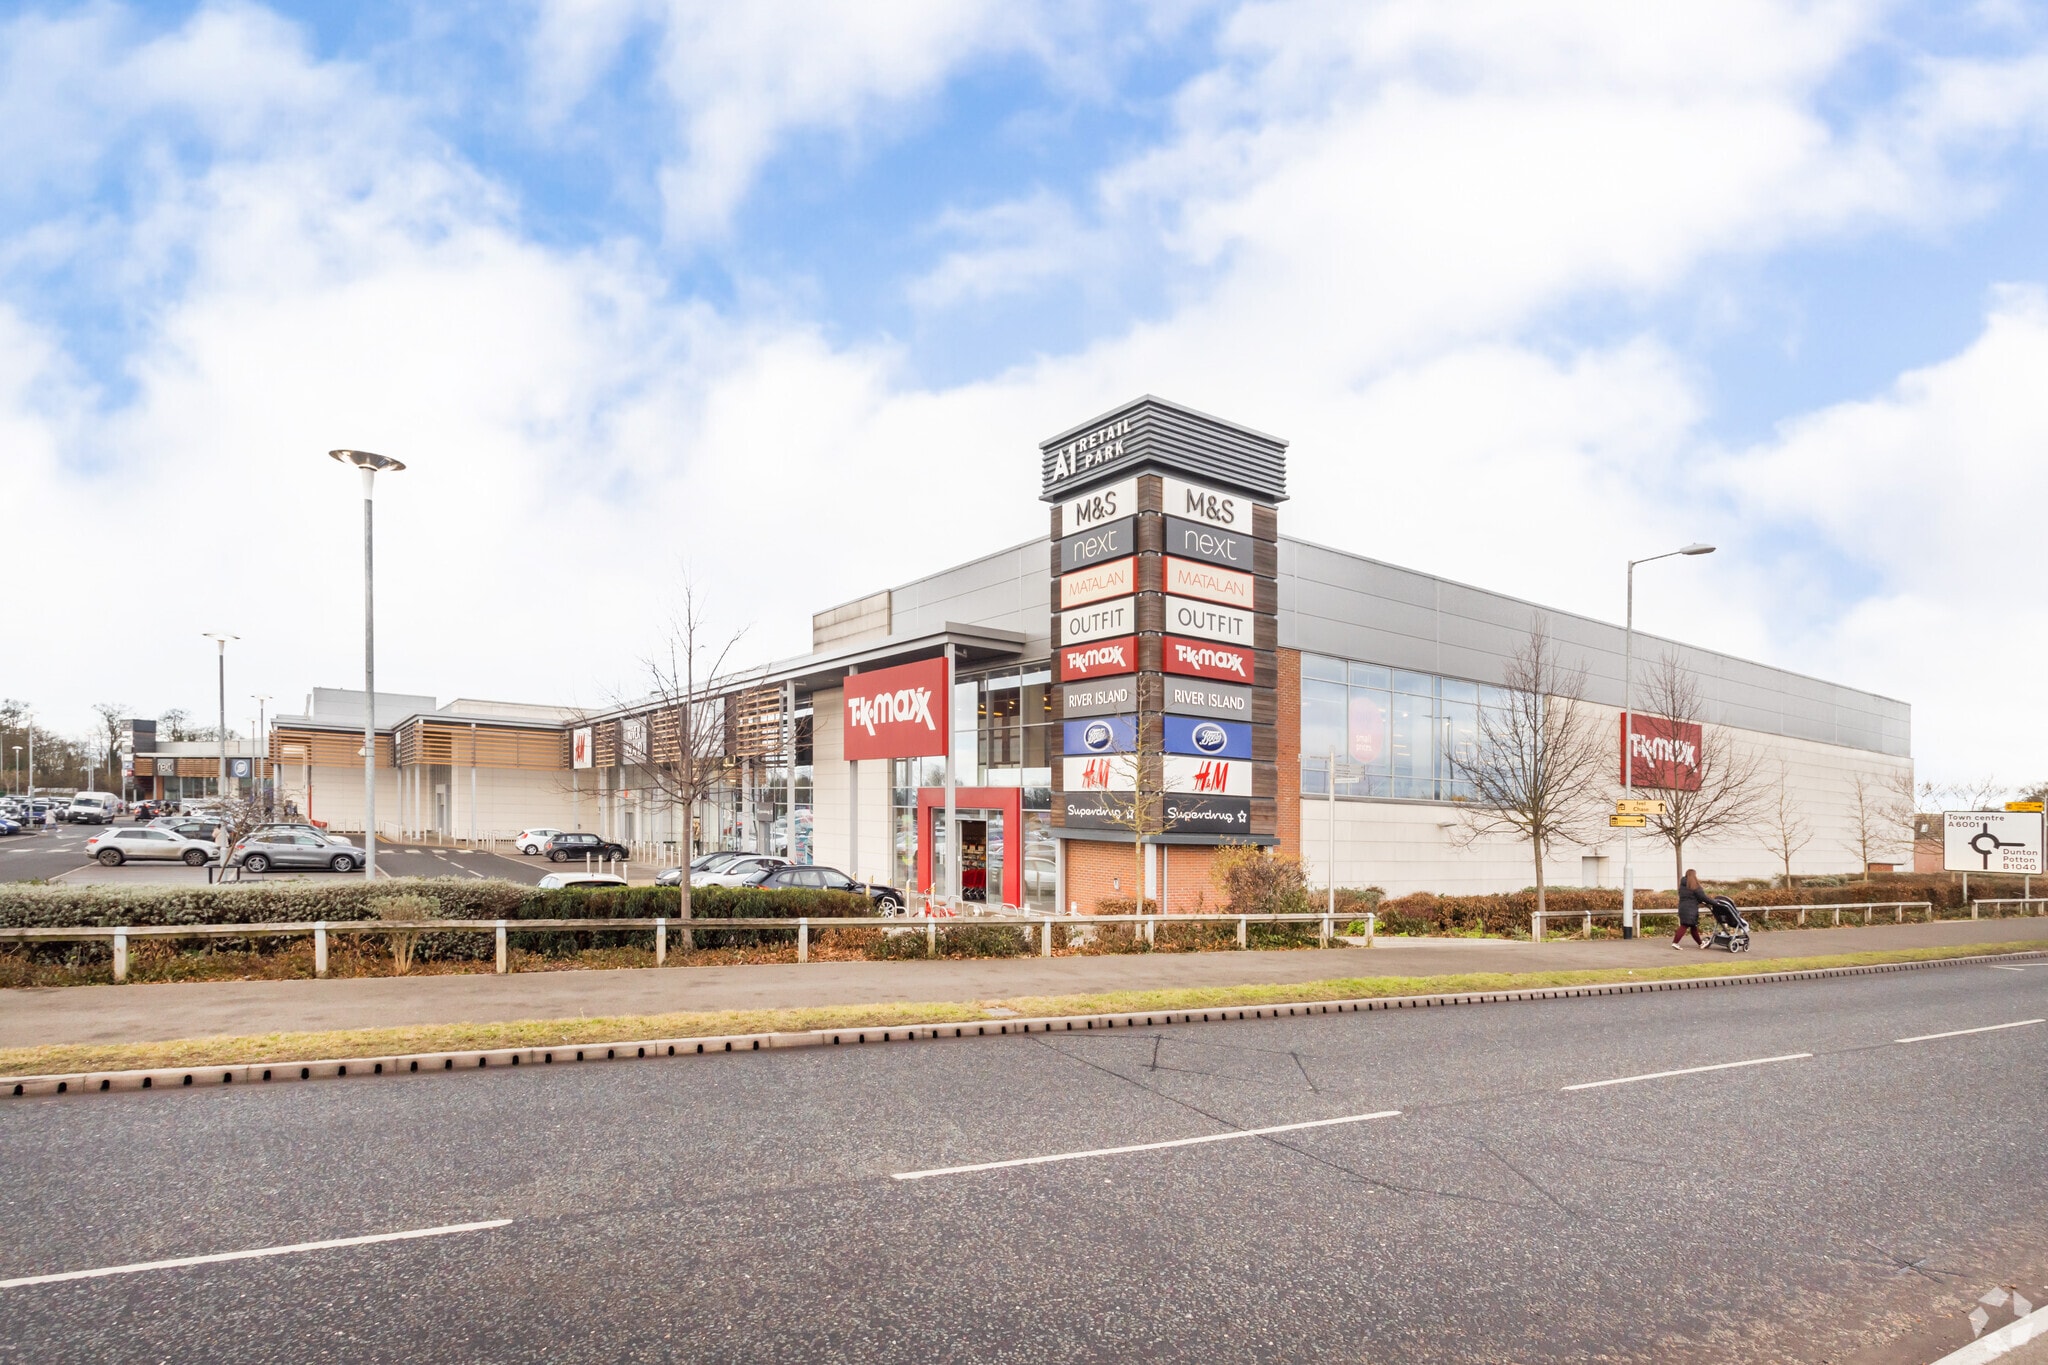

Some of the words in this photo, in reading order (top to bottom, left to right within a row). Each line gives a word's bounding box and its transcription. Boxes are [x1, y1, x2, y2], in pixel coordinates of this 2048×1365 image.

[1053, 442, 1077, 481] A1
[1079, 419, 1132, 453] RETAIL
[1085, 440, 1124, 468] PARK
[1076, 490, 1117, 526] M&S
[1186, 488, 1235, 525] M&S
[1073, 530, 1118, 562] next
[1185, 529, 1238, 561] next
[1069, 570, 1124, 597] MATALAN
[1178, 569, 1245, 597] MATALAN
[1069, 608, 1124, 636] OUTFIT
[1178, 608, 1243, 636] OUTFIT
[1069, 694, 1093, 708] RIVER
[1095, 688, 1128, 703] ISLAND
[1174, 689, 1205, 706] RIVER
[1208, 693, 1245, 710] ISLAND
[1199, 729, 1222, 746] Boots
[1356, 735, 1372, 744] small
[1082, 758, 1111, 789] H&M
[1192, 760, 1229, 793] H&M
[1067, 804, 1122, 819] Superdrug
[1167, 806, 1234, 823] Superdrug
